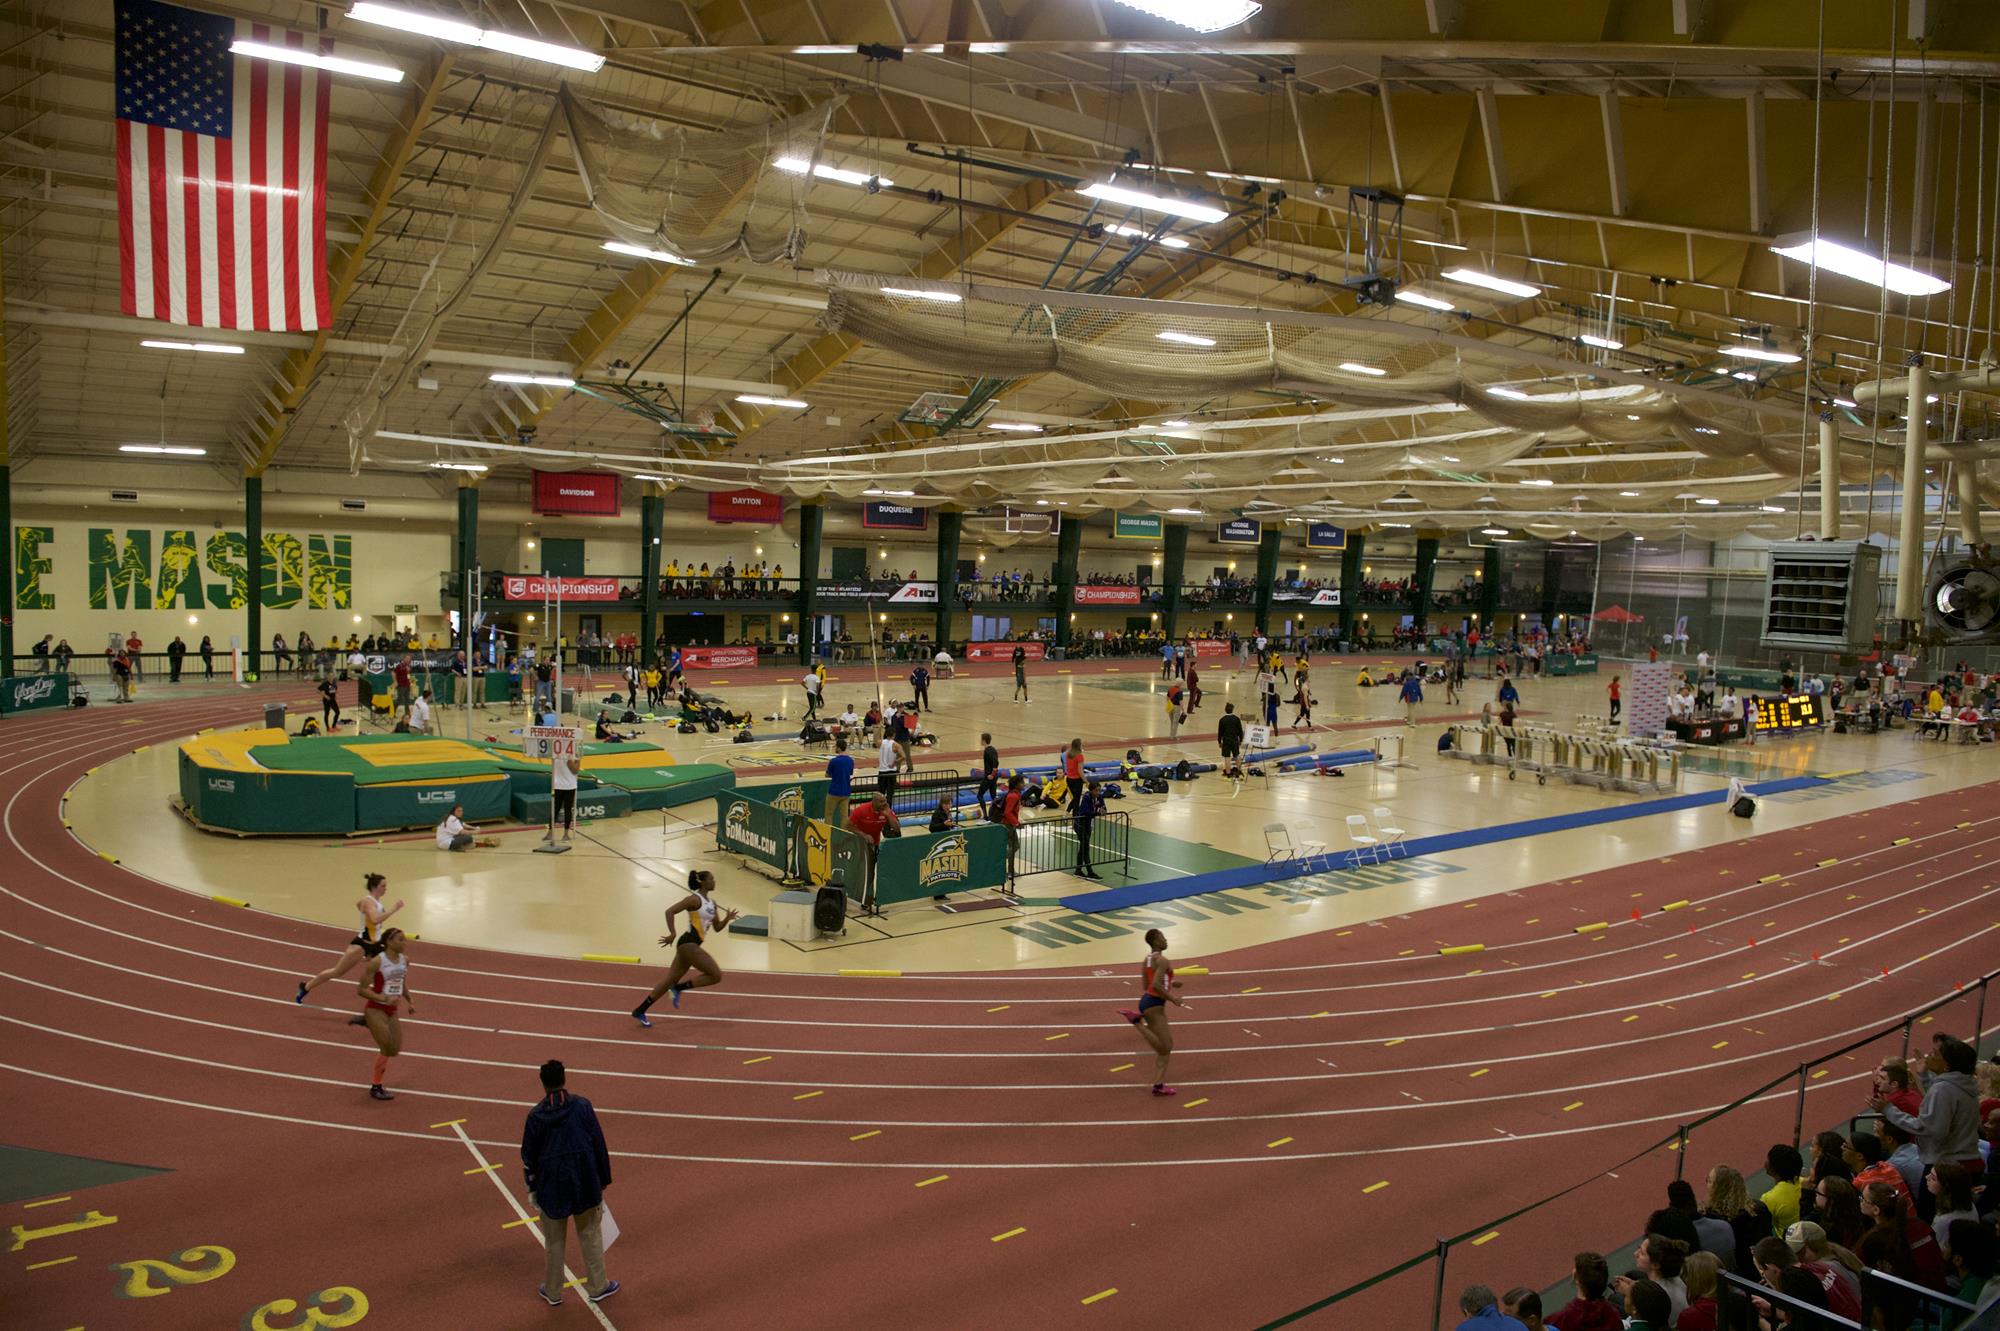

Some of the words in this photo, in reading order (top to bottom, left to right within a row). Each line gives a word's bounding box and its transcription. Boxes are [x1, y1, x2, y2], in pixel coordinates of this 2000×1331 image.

[560, 489, 594, 497] DAVIDSON
[732, 497, 761, 505] DAYTON
[879, 505, 913, 514] DUQUESNE
[1120, 518, 1140, 526] GEORGE
[1140, 519, 1159, 527] MASON
[1225, 528, 1255, 536] WASHINGTON
[88, 528, 352, 610] MASON
[530, 583, 615, 594] CHAMPIONSHIP
[1087, 591, 1137, 599] CHAMPIONSHIPS
[530, 727, 576, 739] PERFORMANCE
[208, 778, 235, 789] UCS
[417, 790, 457, 802] UCS
[578, 805, 605, 817] UCS
[920, 853, 968, 884] MASON
[929, 872, 959, 882] PATRIOTS
[119, 1244, 237, 1298] 2
[250, 1286, 370, 1331] 3
